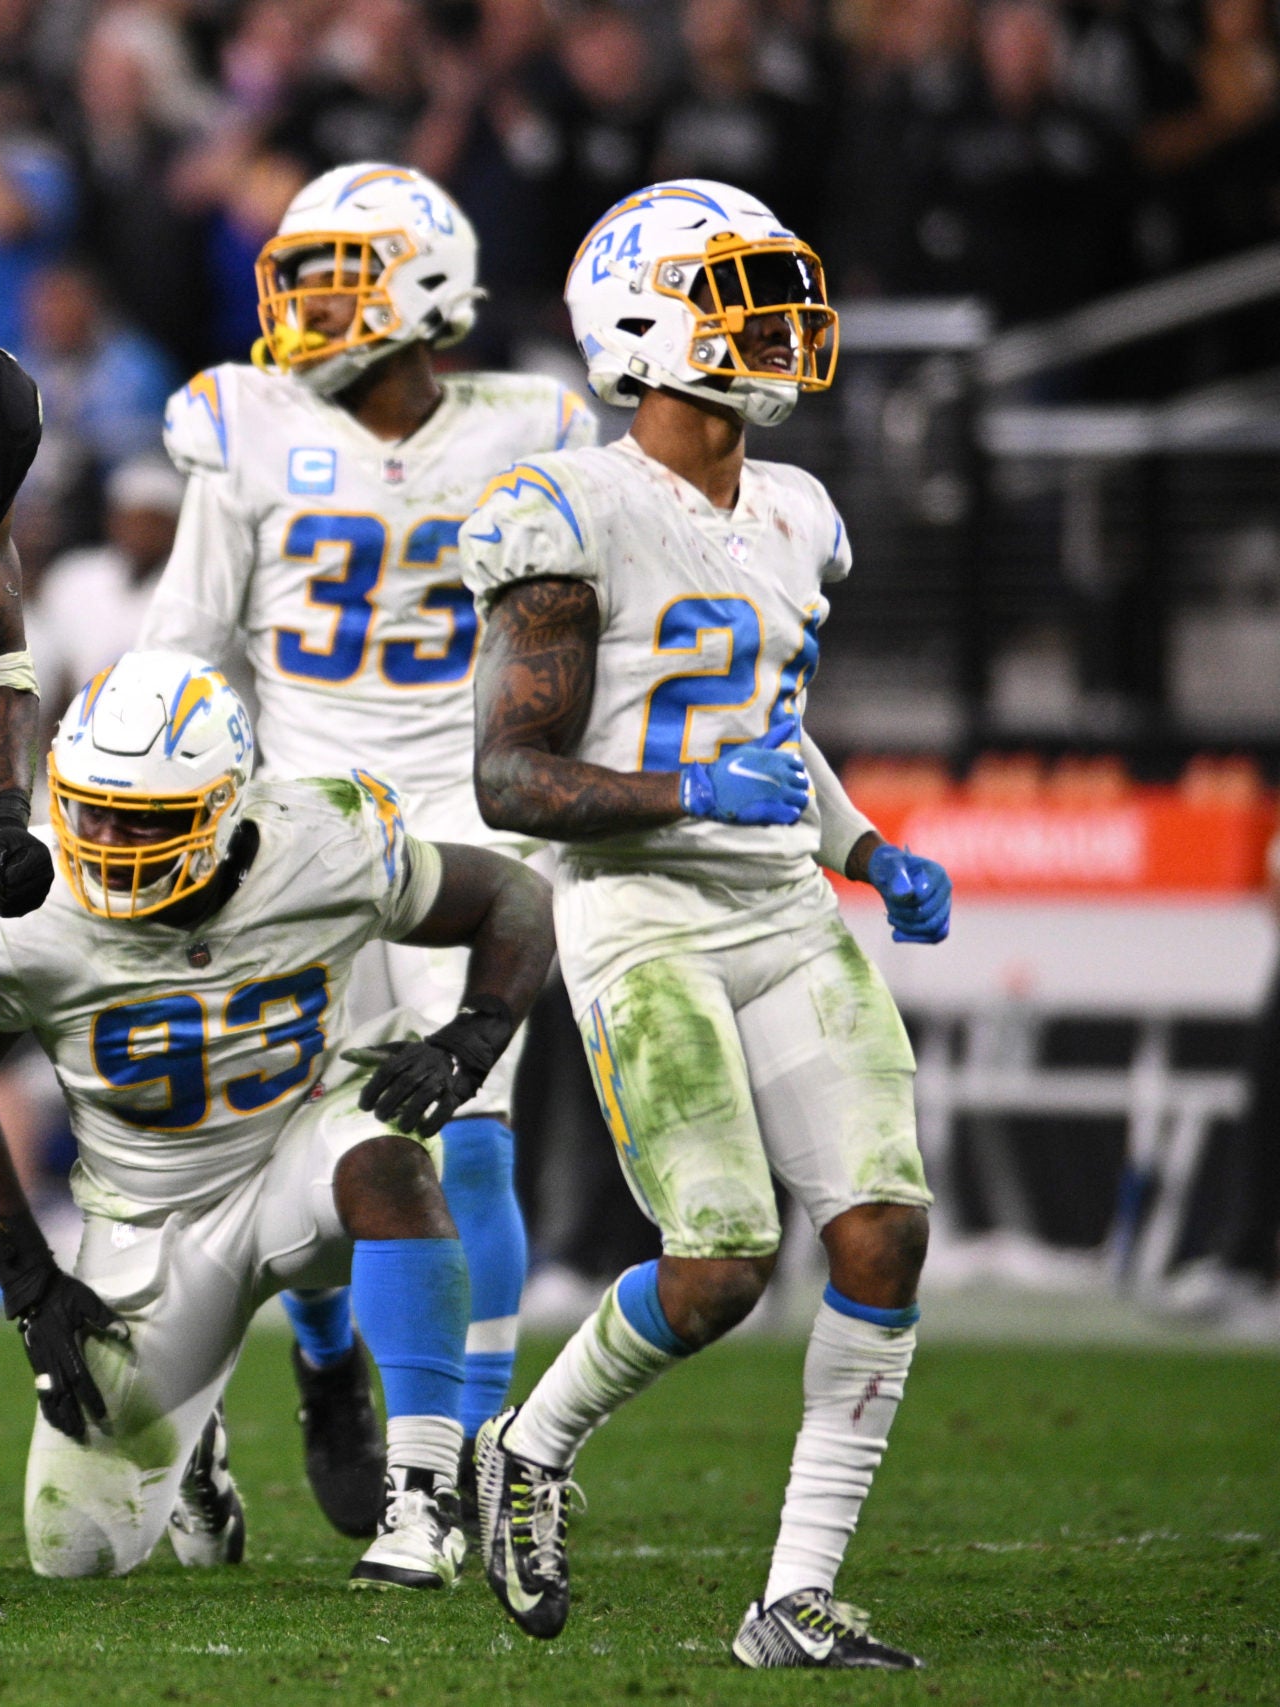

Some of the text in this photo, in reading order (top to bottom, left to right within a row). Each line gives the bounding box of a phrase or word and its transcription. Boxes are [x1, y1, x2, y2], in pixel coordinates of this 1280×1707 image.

[591, 222, 642, 284] 24
[291, 449, 333, 482] C
[271, 509, 485, 691] 33
[89, 961, 332, 1133] 93
